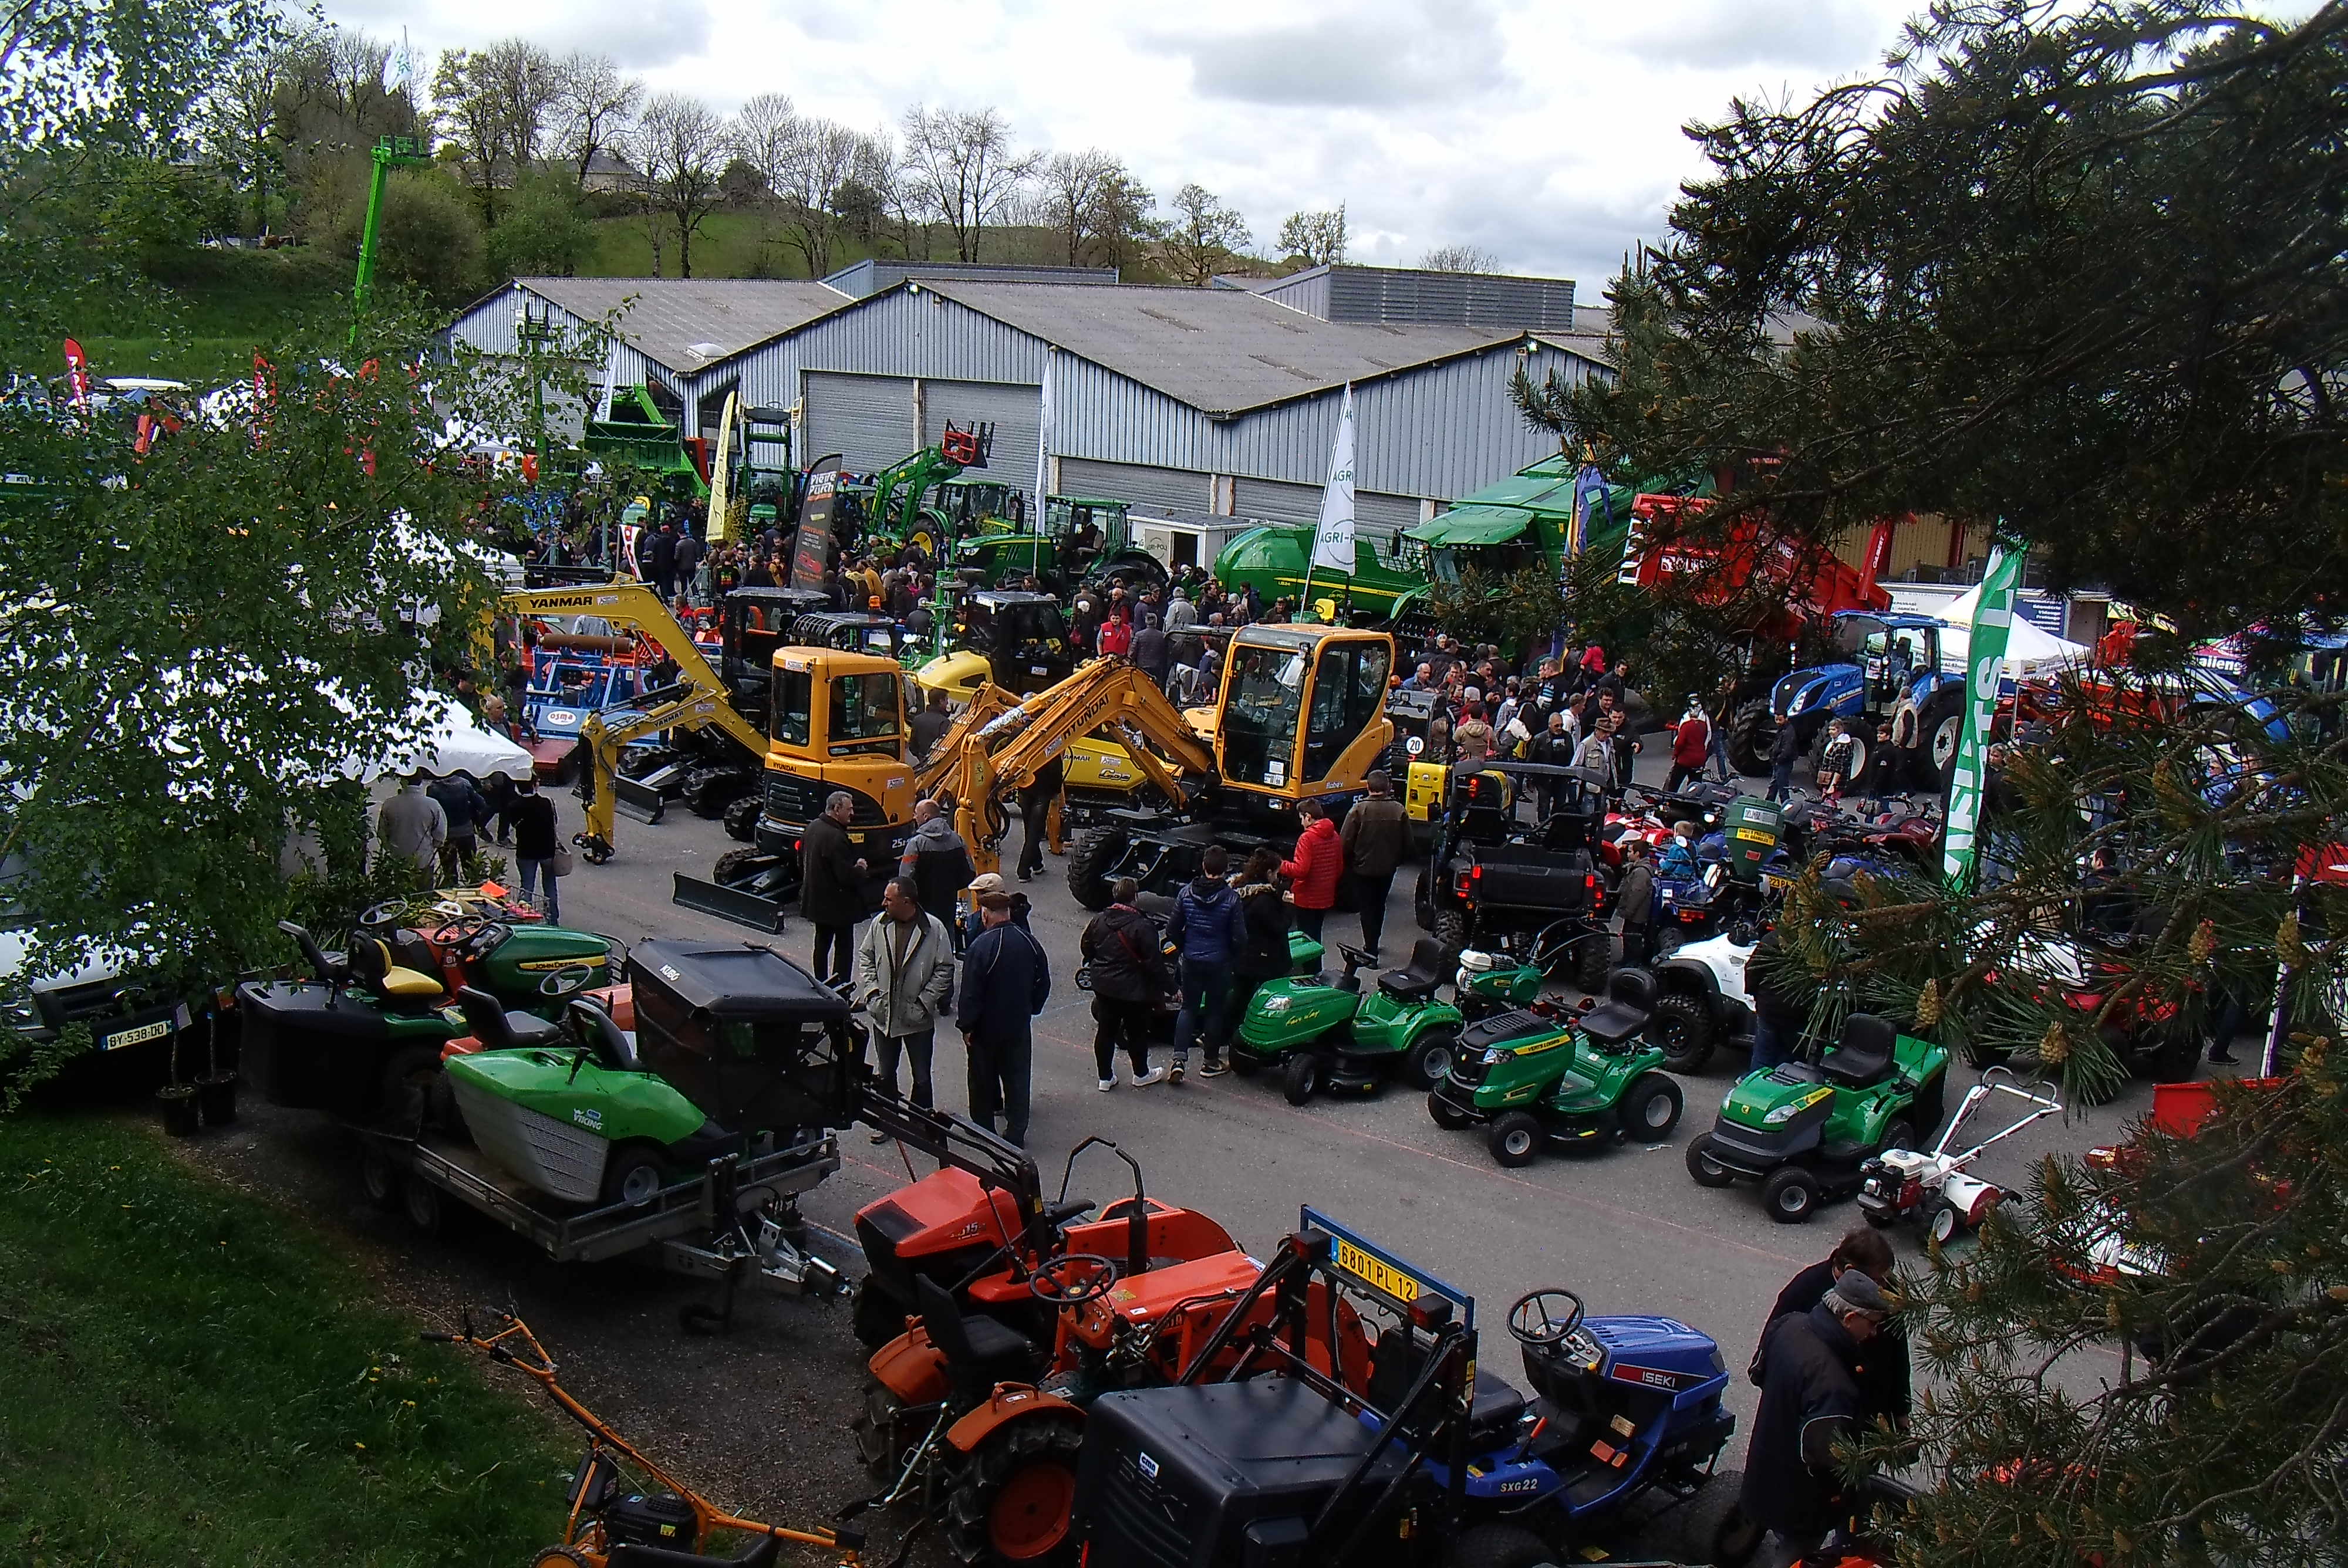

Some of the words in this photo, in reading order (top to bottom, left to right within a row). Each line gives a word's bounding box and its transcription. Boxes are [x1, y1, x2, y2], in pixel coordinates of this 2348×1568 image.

[529, 596, 593, 609] YANMAR
[654, 709, 684, 728] YANMAR
[1062, 693, 1109, 740] HYUNDAI
[1409, 739, 1421, 751] 20
[1063, 753, 1091, 762] ANMAR
[772, 762, 797, 772] HYUNDAI
[573, 1114, 604, 1131] VIKING
[1341, 1245, 1371, 1280] 6801
[1377, 1264, 1392, 1292] PL
[1398, 1276, 1413, 1302] 12
[1642, 1370, 1676, 1388] ISEKI
